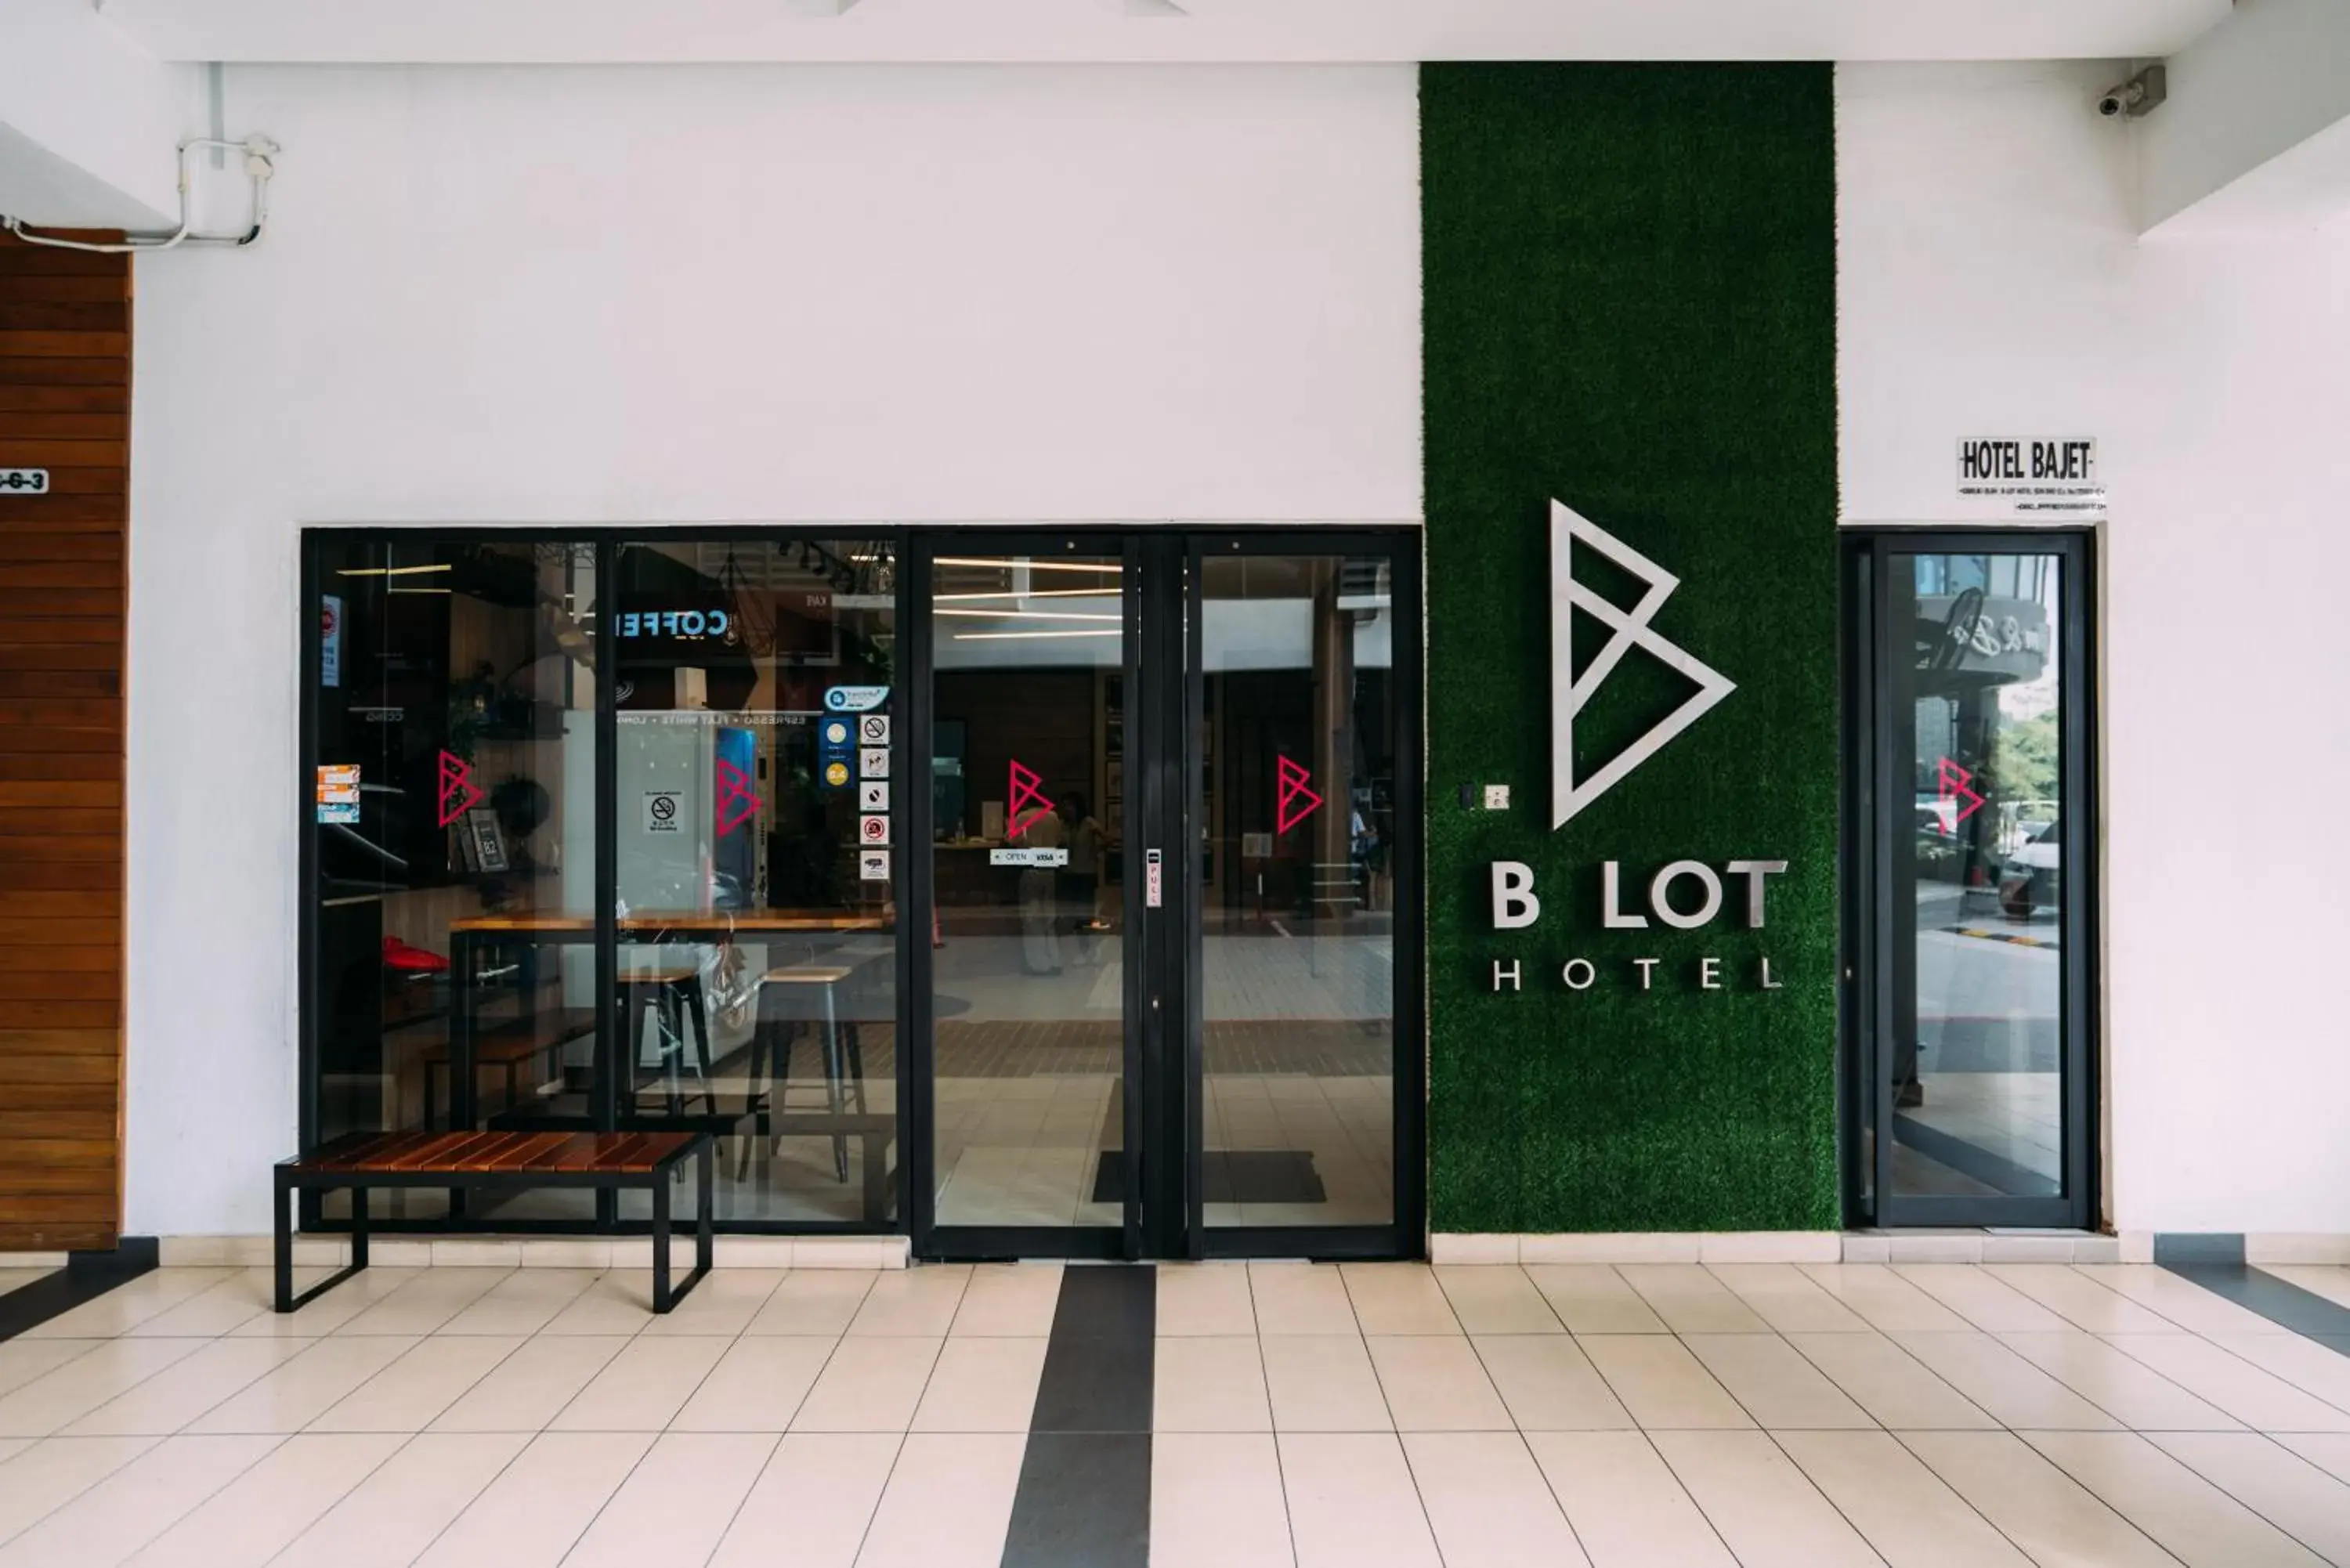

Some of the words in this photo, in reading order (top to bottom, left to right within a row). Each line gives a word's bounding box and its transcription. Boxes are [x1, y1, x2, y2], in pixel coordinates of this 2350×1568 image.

[1964, 441, 2024, 479] HOTEL
[2032, 441, 2090, 479] BAJET
[1491, 861, 1541, 929] B
[1603, 860, 1789, 929] LOT
[1493, 958, 1784, 992] HOTEL
